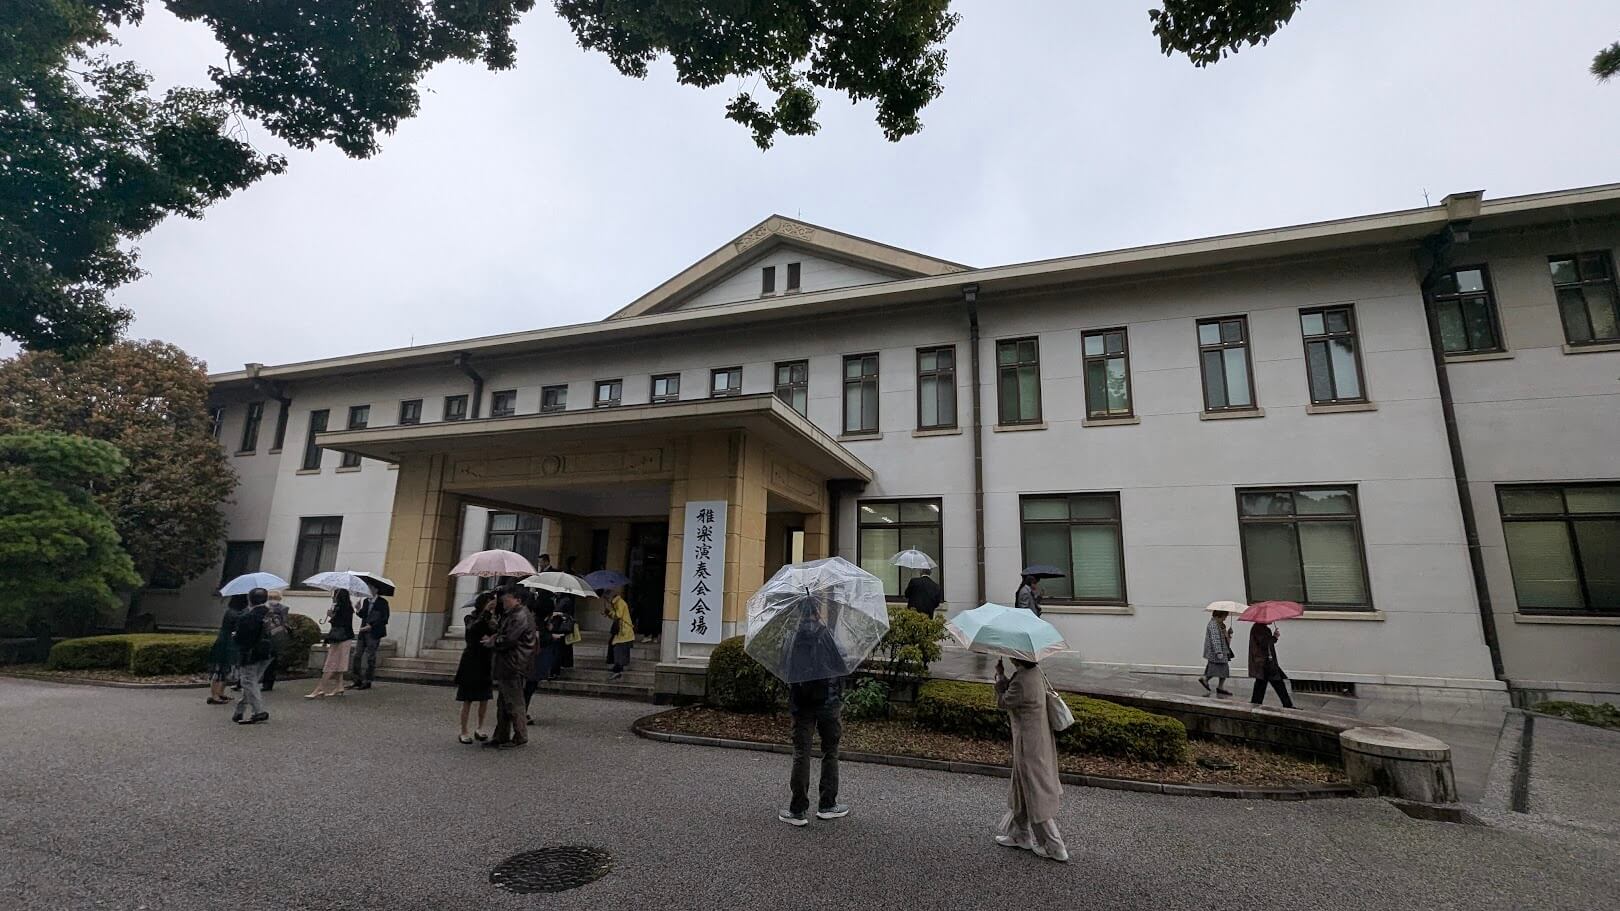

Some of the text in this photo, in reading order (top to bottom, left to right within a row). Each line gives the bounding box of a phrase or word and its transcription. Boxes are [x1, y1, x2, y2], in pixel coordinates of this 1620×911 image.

[688, 508, 716, 635] 雅楽演奏会会場
